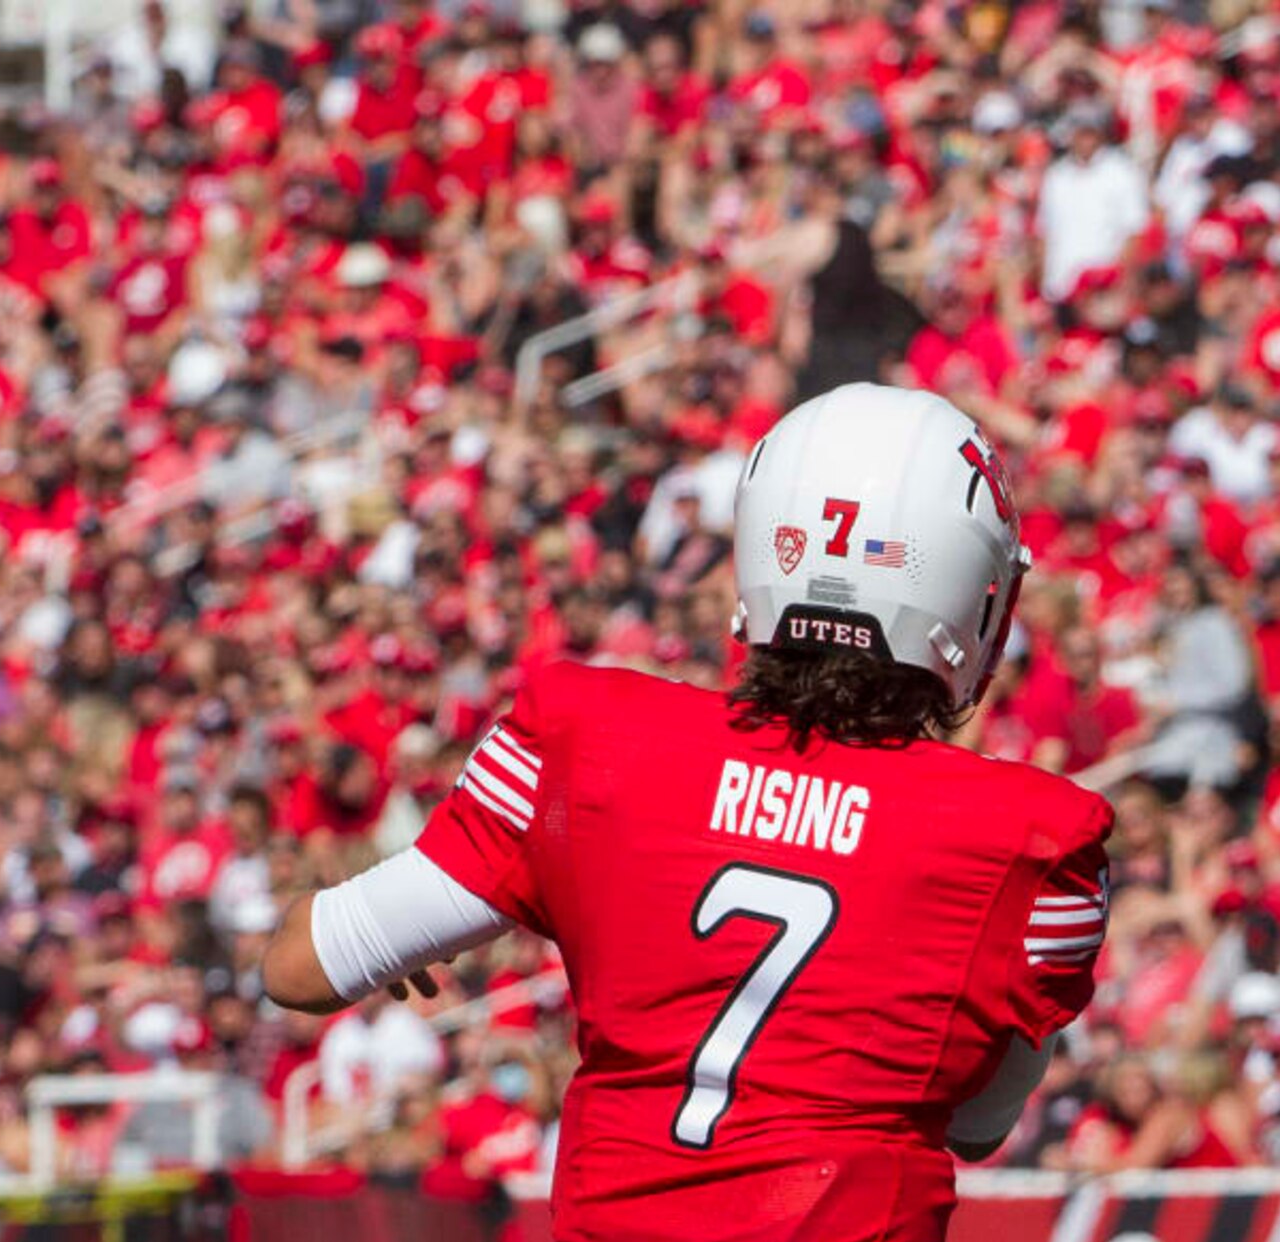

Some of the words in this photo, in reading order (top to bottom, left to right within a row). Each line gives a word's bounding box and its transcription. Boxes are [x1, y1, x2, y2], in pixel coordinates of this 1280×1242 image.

[822, 496, 860, 558] 7
[789, 618, 872, 649] UTES
[709, 758, 871, 855] RISING
[671, 860, 840, 1150] 7
